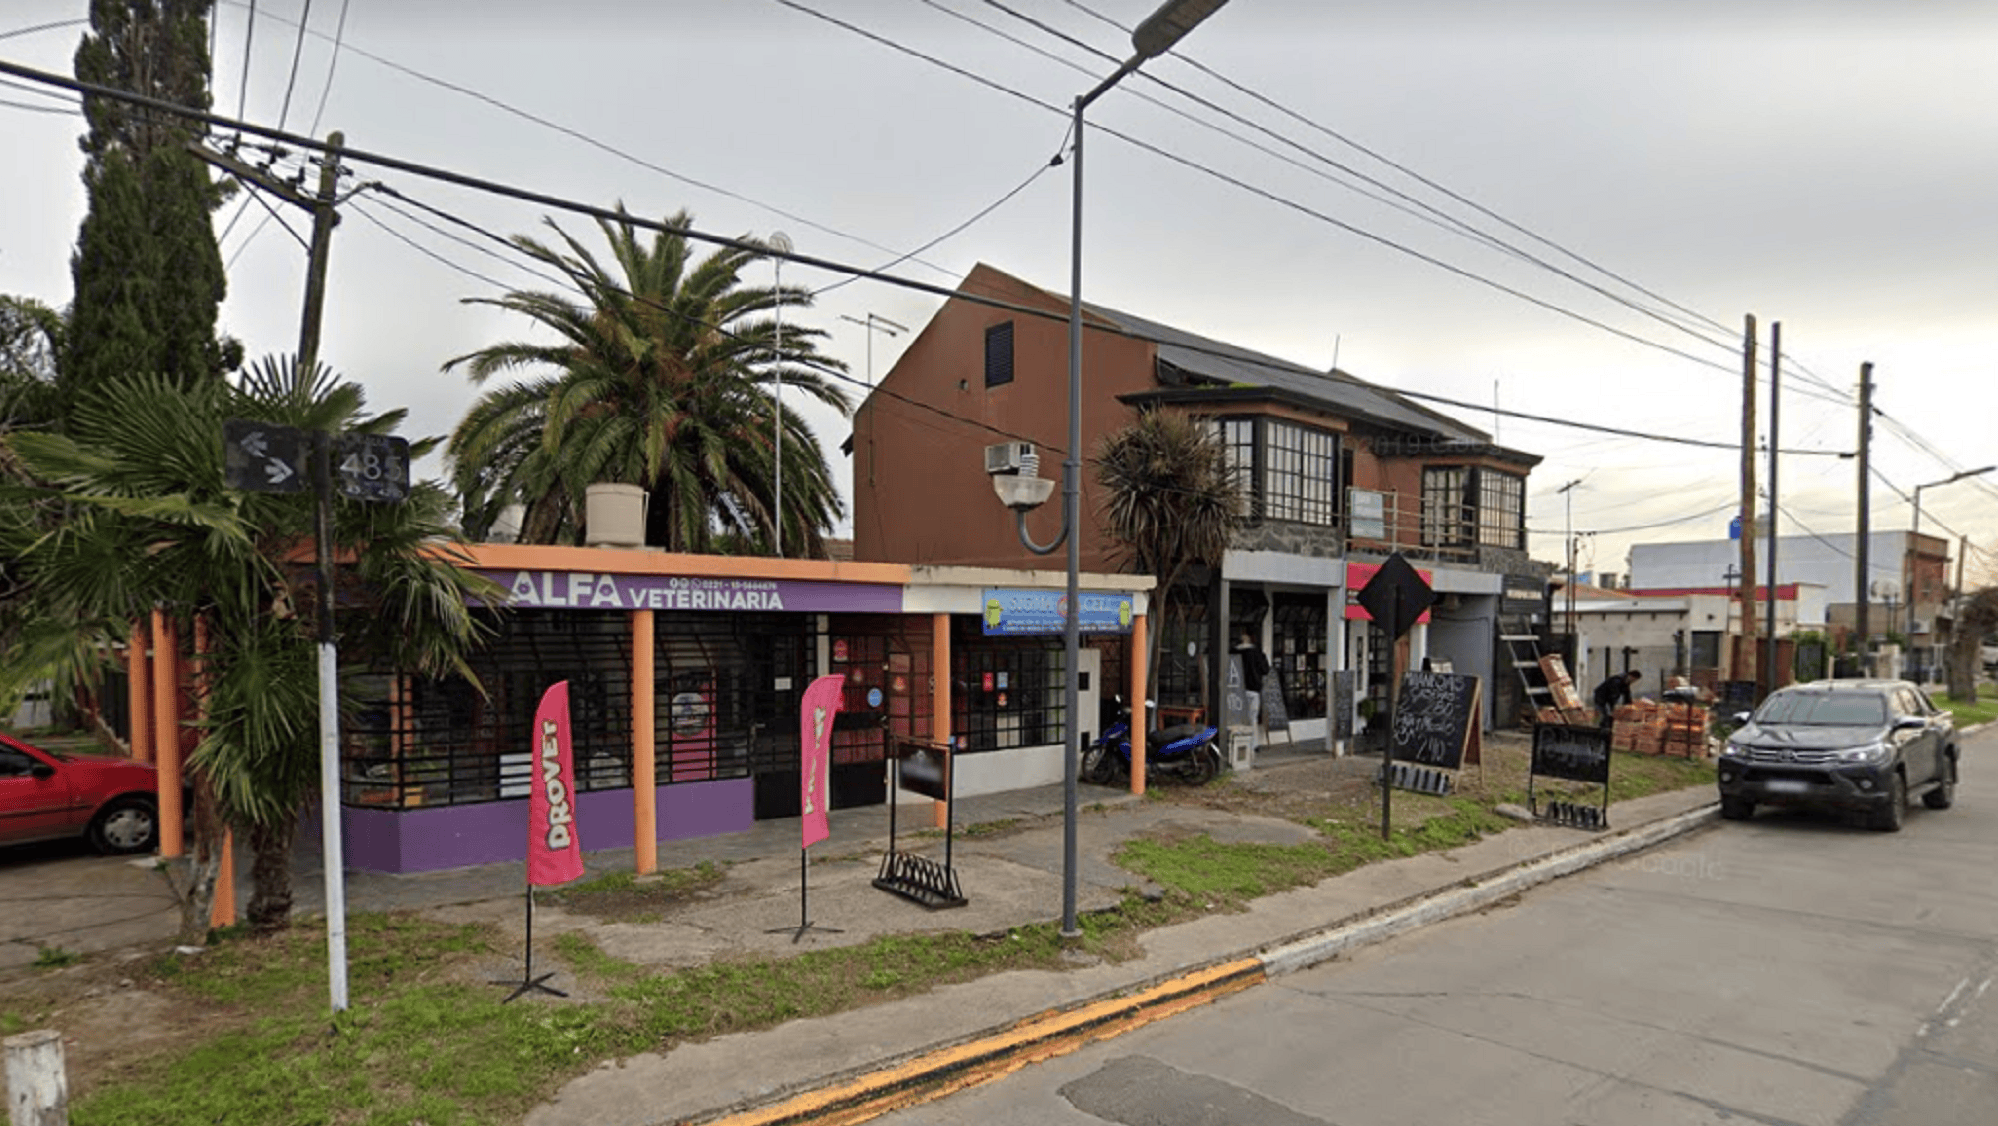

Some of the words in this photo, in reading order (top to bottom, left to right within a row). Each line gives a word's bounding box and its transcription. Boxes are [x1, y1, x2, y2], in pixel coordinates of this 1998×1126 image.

[340, 452, 402, 481] 485
[508, 571, 624, 607] ALFA
[628, 588, 784, 610] VETERINARIA
[541, 719, 572, 849] DROVET
